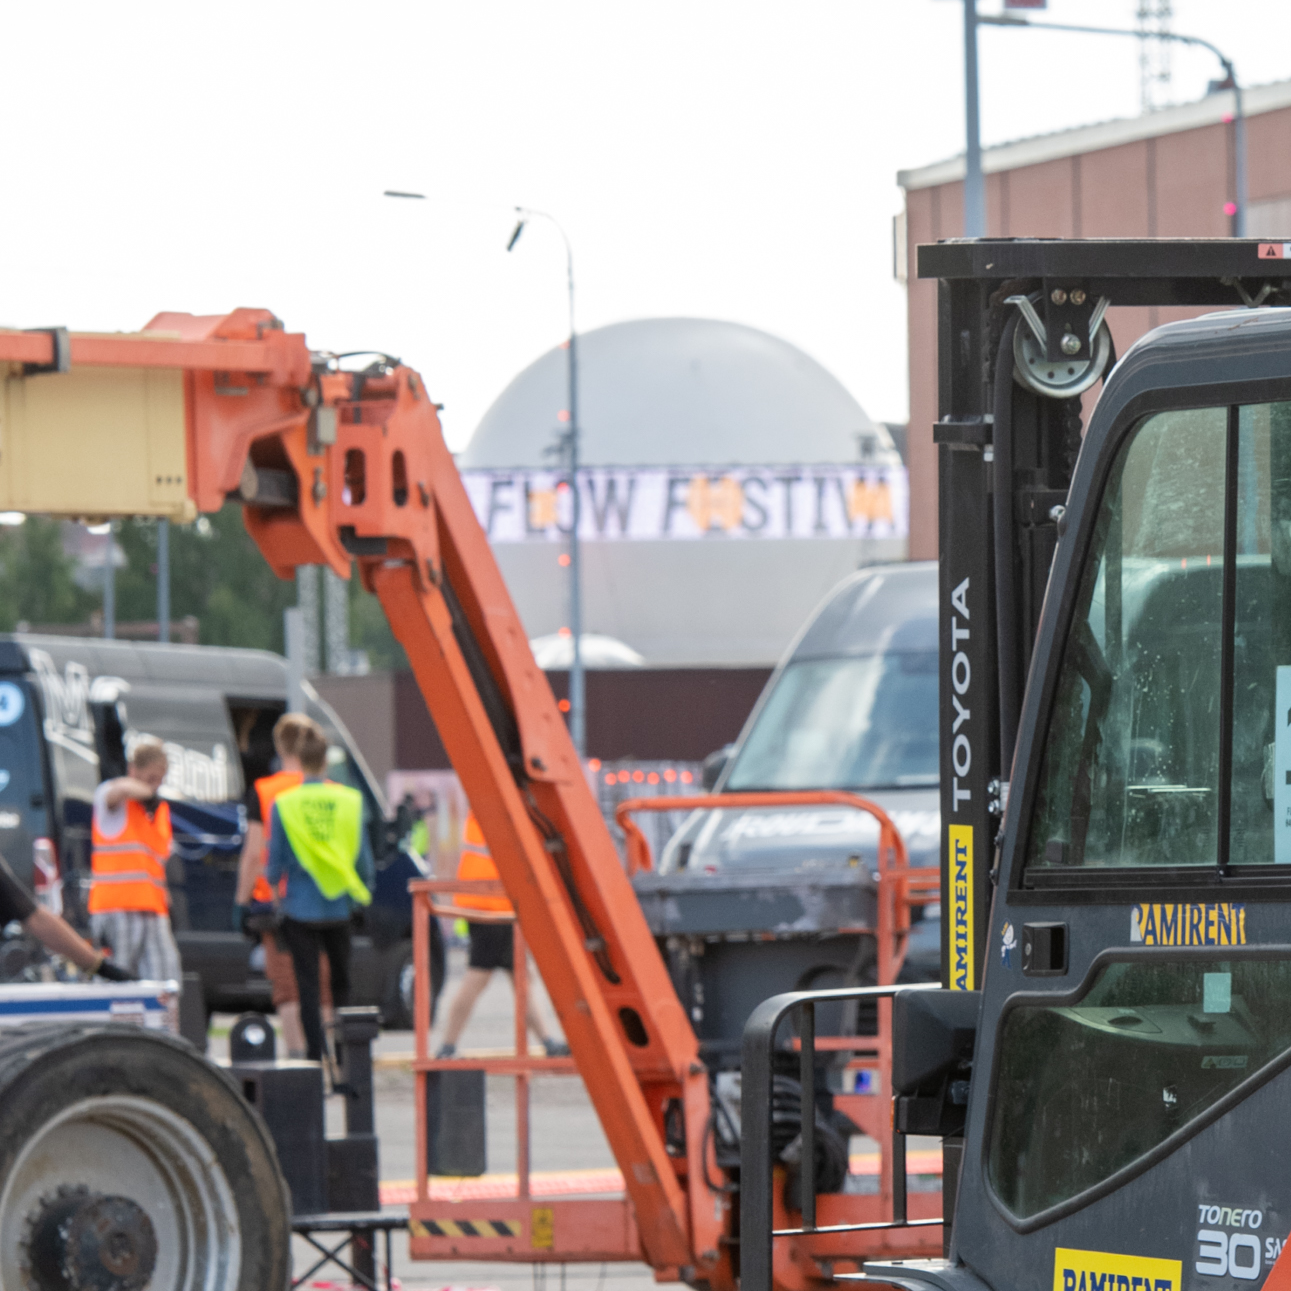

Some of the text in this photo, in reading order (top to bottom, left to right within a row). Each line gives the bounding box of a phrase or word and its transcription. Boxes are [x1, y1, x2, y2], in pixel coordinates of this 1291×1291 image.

[487, 477, 635, 532] FLOW
[951, 576, 972, 812] TOYOTA
[1195, 1229, 1261, 1280] 30
